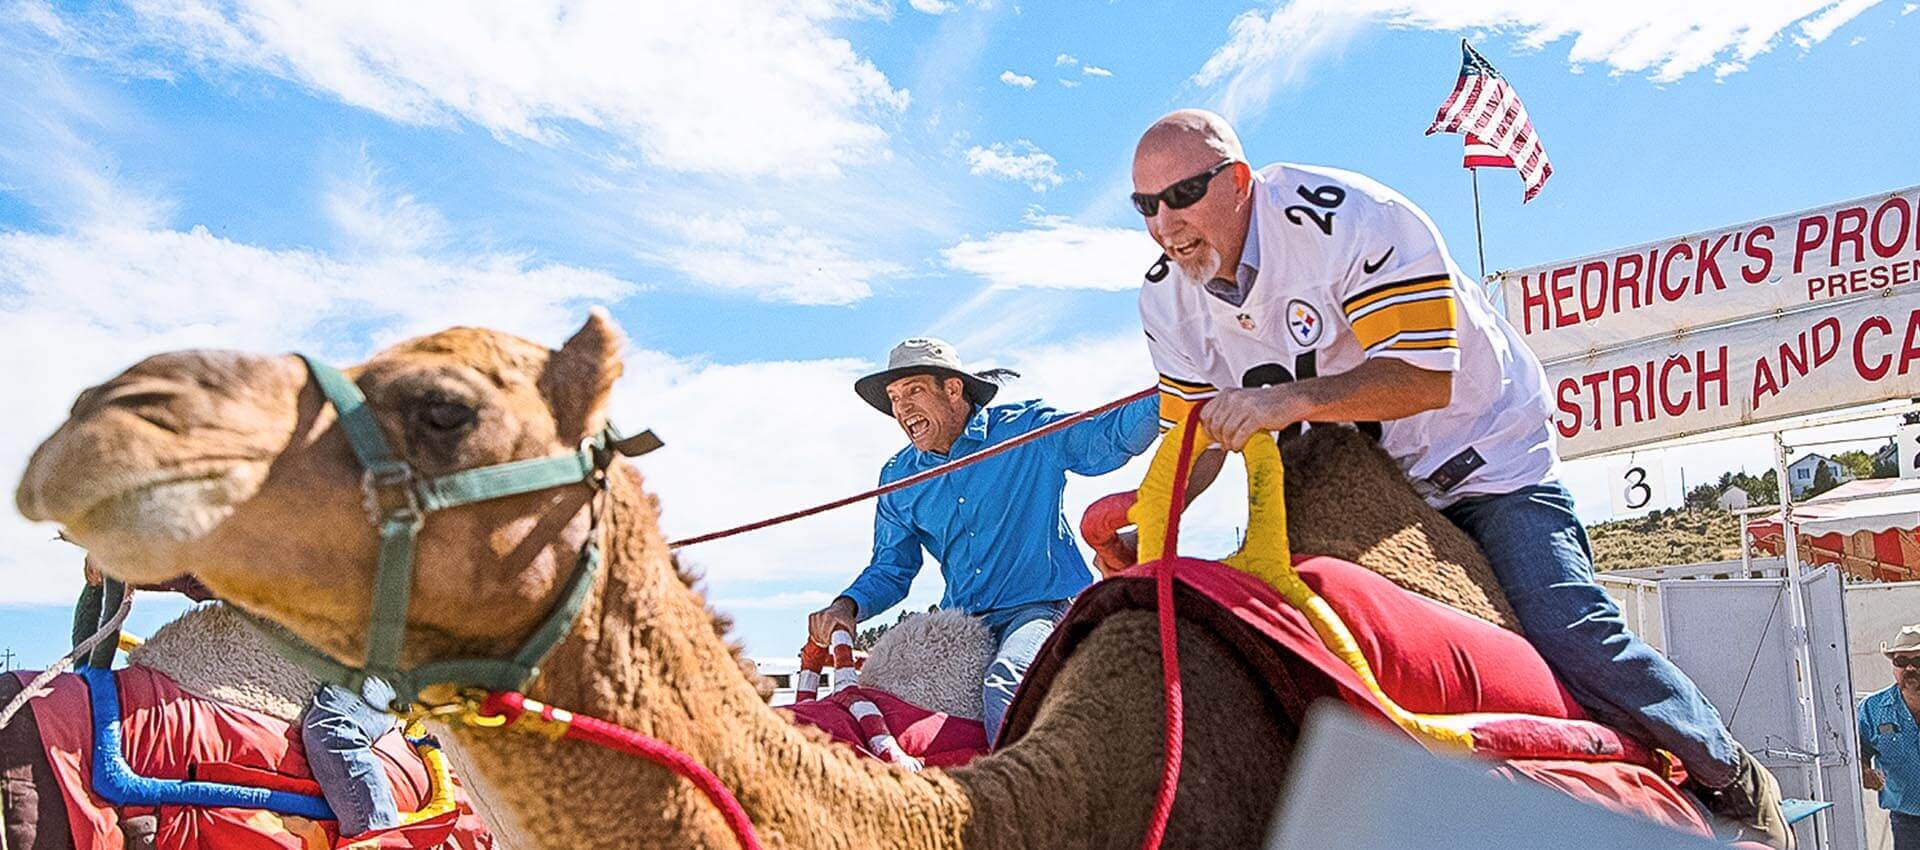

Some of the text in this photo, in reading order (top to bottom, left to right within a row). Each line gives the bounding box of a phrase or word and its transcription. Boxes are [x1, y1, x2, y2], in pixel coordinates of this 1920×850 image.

[1285, 185, 1346, 235] 26
[1521, 197, 1920, 335] HEDRICK'S PRO
[1549, 346, 1728, 438] STRICH
[1753, 317, 1840, 411] AND
[1624, 467, 1651, 509] 3
